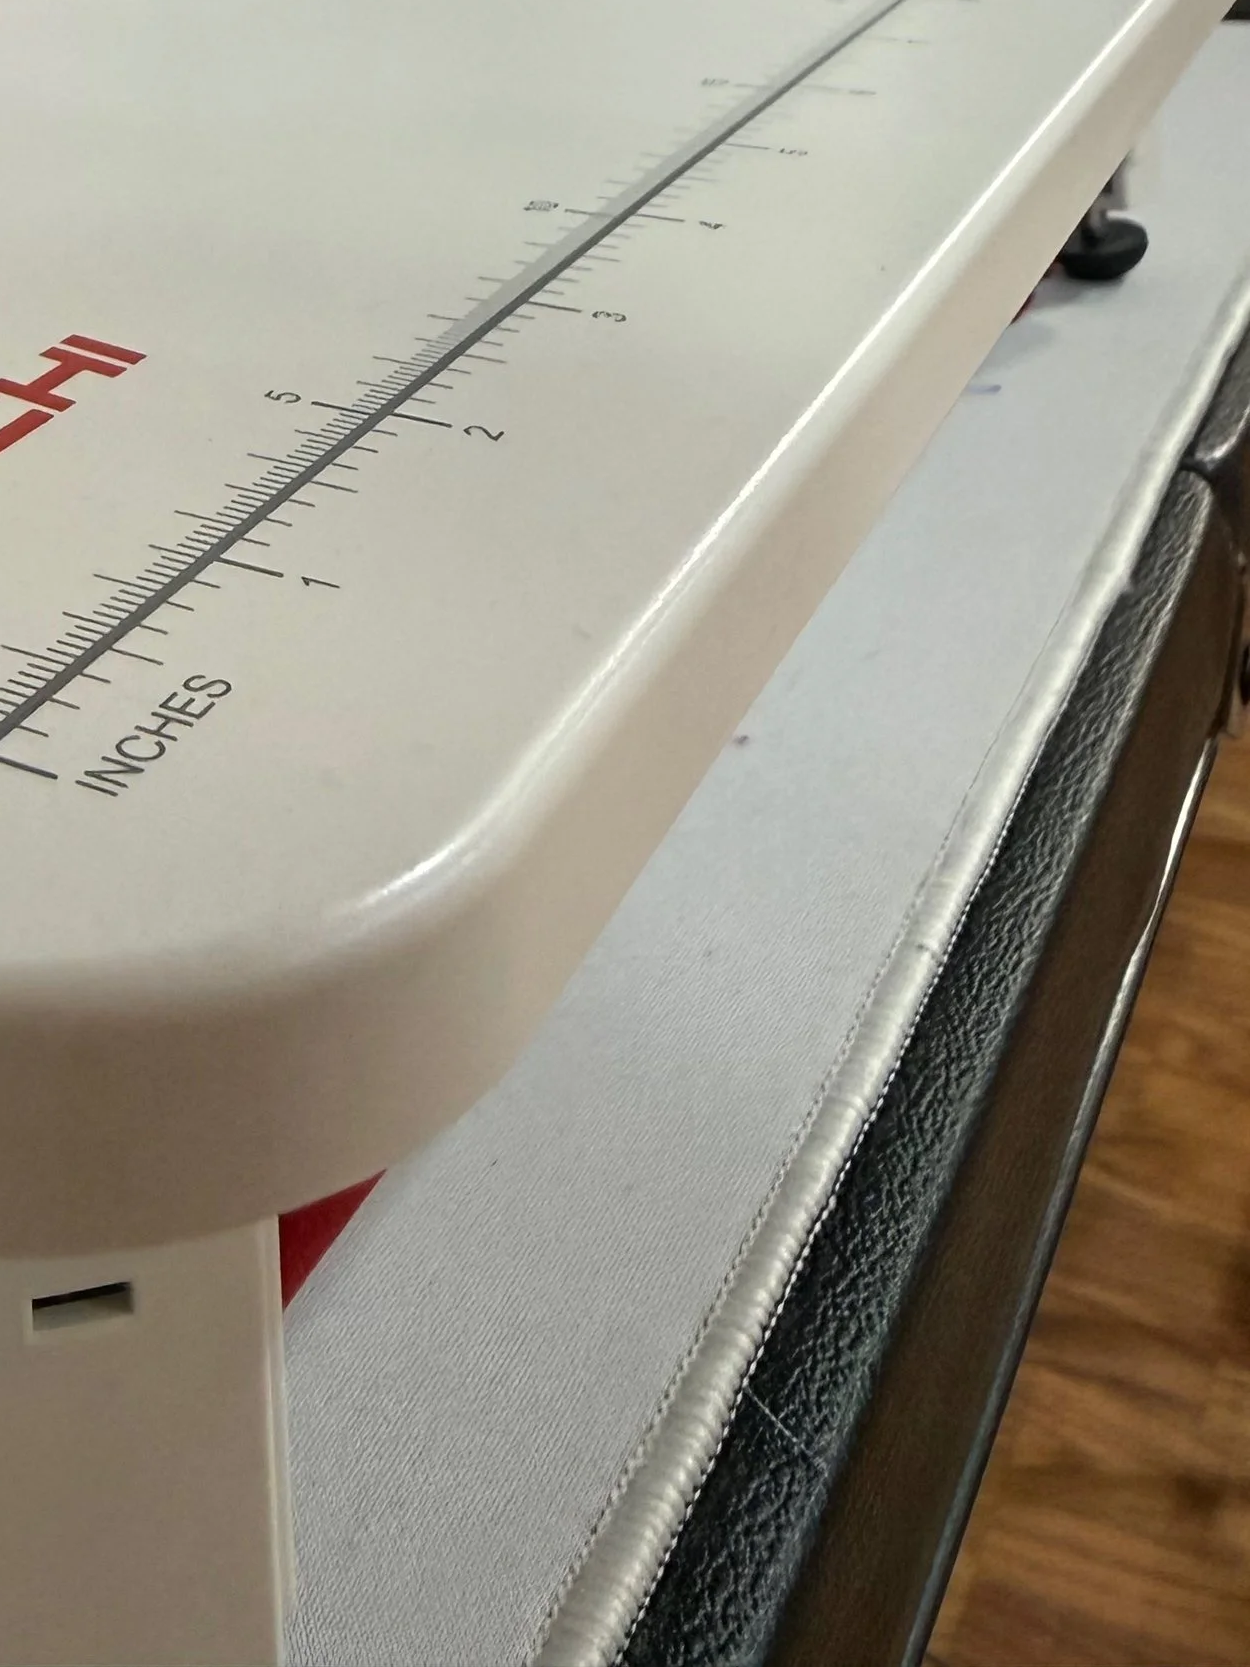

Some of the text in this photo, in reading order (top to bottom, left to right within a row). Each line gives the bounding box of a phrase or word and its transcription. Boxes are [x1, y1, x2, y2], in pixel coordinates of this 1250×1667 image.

[263, 388, 302, 405] 5
[462, 424, 506, 442] 2
[301, 574, 341, 590] 1
[74, 673, 234, 798] INCHES
